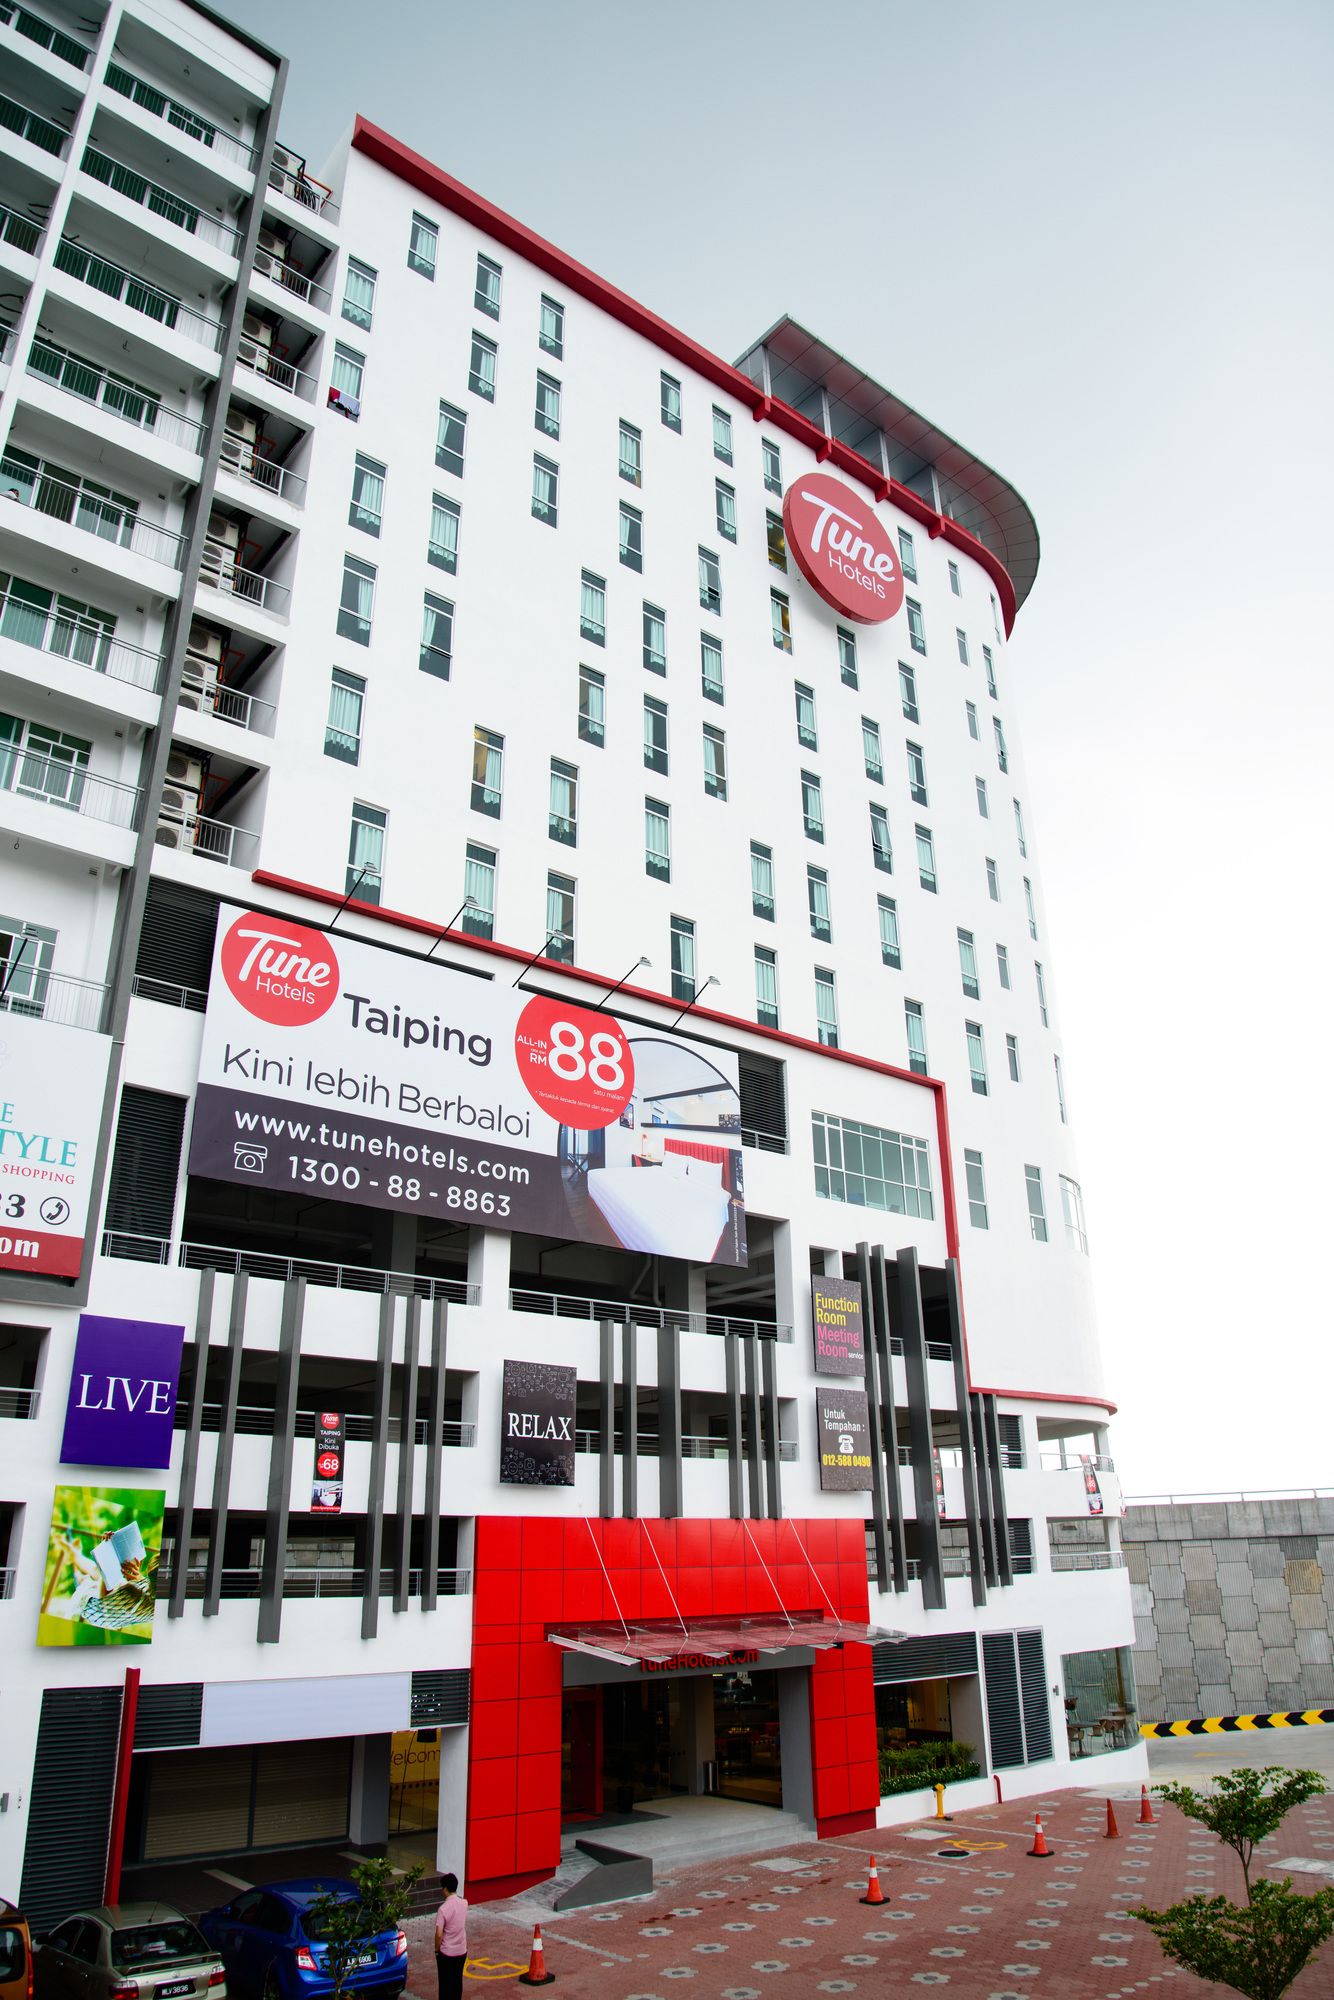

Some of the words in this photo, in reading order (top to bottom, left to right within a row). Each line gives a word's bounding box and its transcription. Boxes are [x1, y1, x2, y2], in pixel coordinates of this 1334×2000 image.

[801, 491, 895, 582] Tune
[828, 551, 886, 599] Hotels
[237, 929, 331, 987] Tune
[256, 975, 316, 1005] Hotels
[343, 992, 493, 1067] Taiping
[517, 1034, 547, 1050] ALL-IN
[530, 1052, 547, 1066] RM
[223, 1043, 294, 1086] Kini
[305, 1060, 390, 1108] lebih
[398, 1083, 531, 1138] Berbaloi
[234, 1110, 530, 1185] www.tunehotels.com
[2, 1163, 76, 1185] SHOPPING
[289, 1155, 361, 1190] 1300
[387, 1175, 421, 1201] 88
[446, 1186, 511, 1217] 8863
[0, 1192, 26, 1219] 3
[815, 1292, 860, 1314] Function
[816, 1307, 847, 1326] Room
[817, 1325, 860, 1349] Meeting
[818, 1340, 848, 1359] Room
[848, 1352, 864, 1360] service
[75, 1373, 172, 1415] LIVE
[323, 1413, 339, 1424] Tune
[823, 1408, 846, 1420] Untuk
[824, 1419, 861, 1432] Tempahan
[320, 1429, 341, 1437] TAIPING
[507, 1412, 572, 1441] RELAX
[318, 1443, 340, 1451] Dibuka
[323, 1458, 339, 1471] 68
